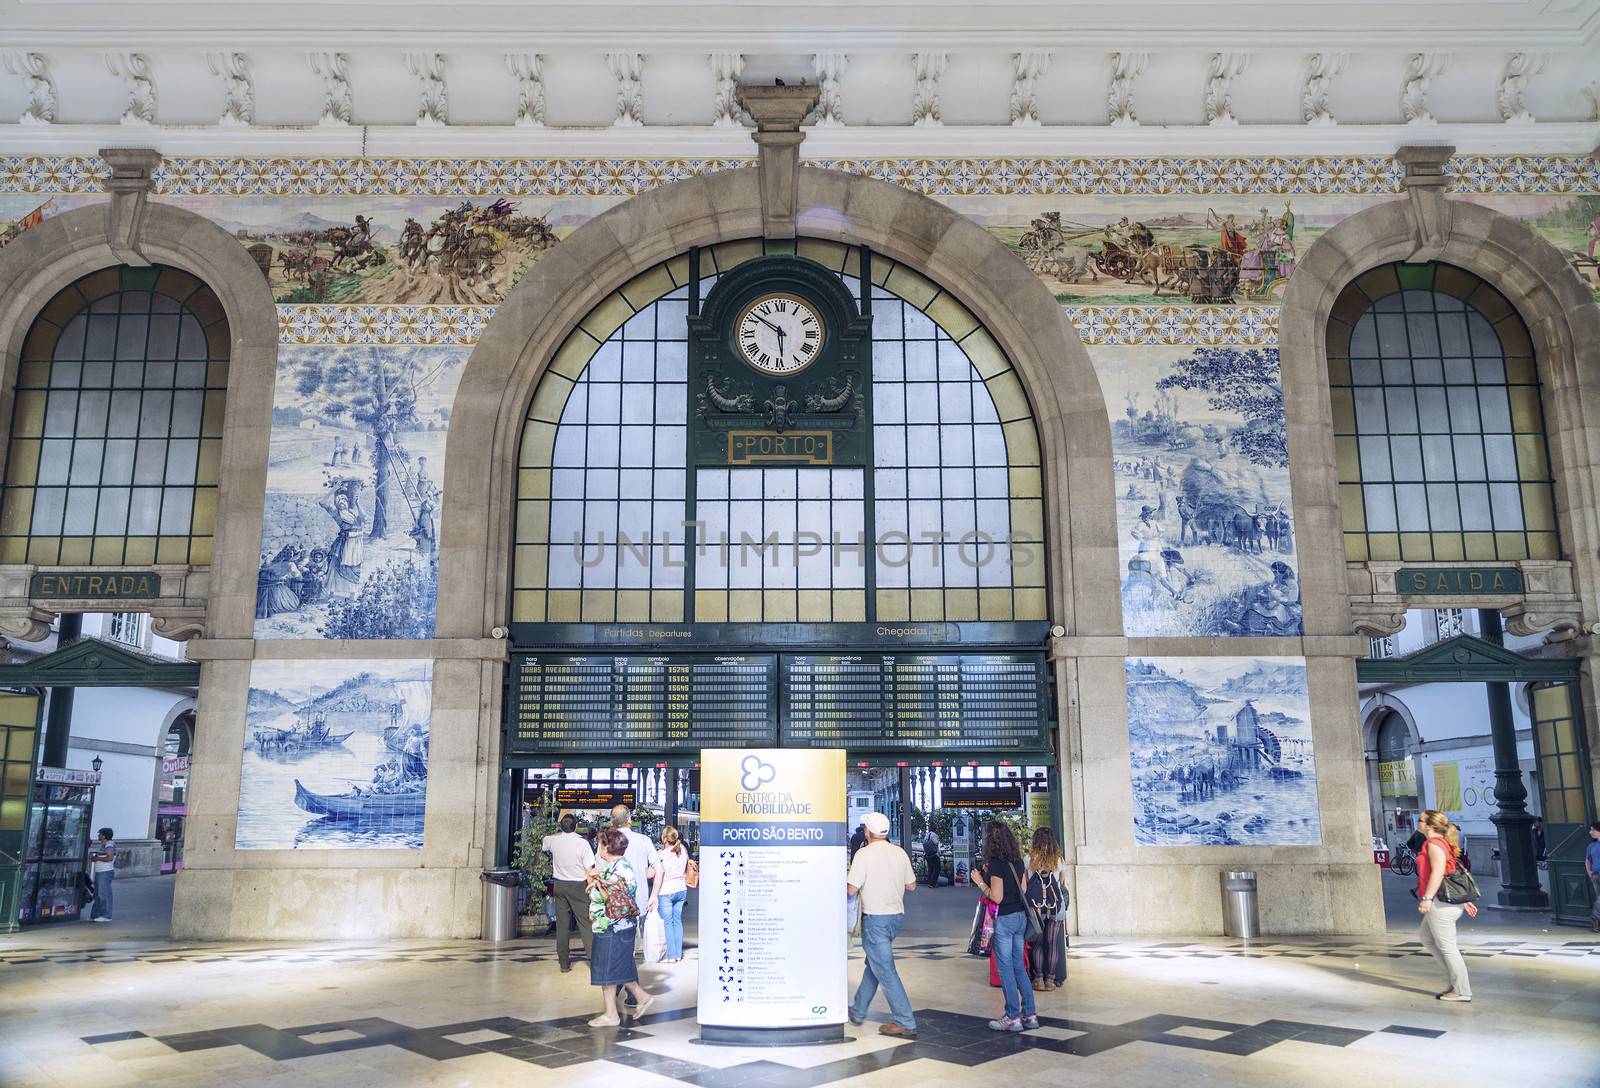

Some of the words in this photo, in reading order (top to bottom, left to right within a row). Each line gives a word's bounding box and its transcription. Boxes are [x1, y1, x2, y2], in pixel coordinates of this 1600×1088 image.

[745, 436, 816, 454] PORTO
[41, 575, 151, 595] ENTRADA
[604, 627, 644, 638] Partidas
[648, 629, 692, 639] Departures
[876, 626, 928, 638] Chegadas
[162, 756, 189, 774] Outlet
[735, 793, 776, 803] CENTRO
[777, 793, 793, 803] DA
[742, 803, 811, 815] MOBILIDADE
[723, 828, 760, 840] PORTO
[763, 825, 785, 840] SÃO
[787, 828, 823, 840] BENTO
